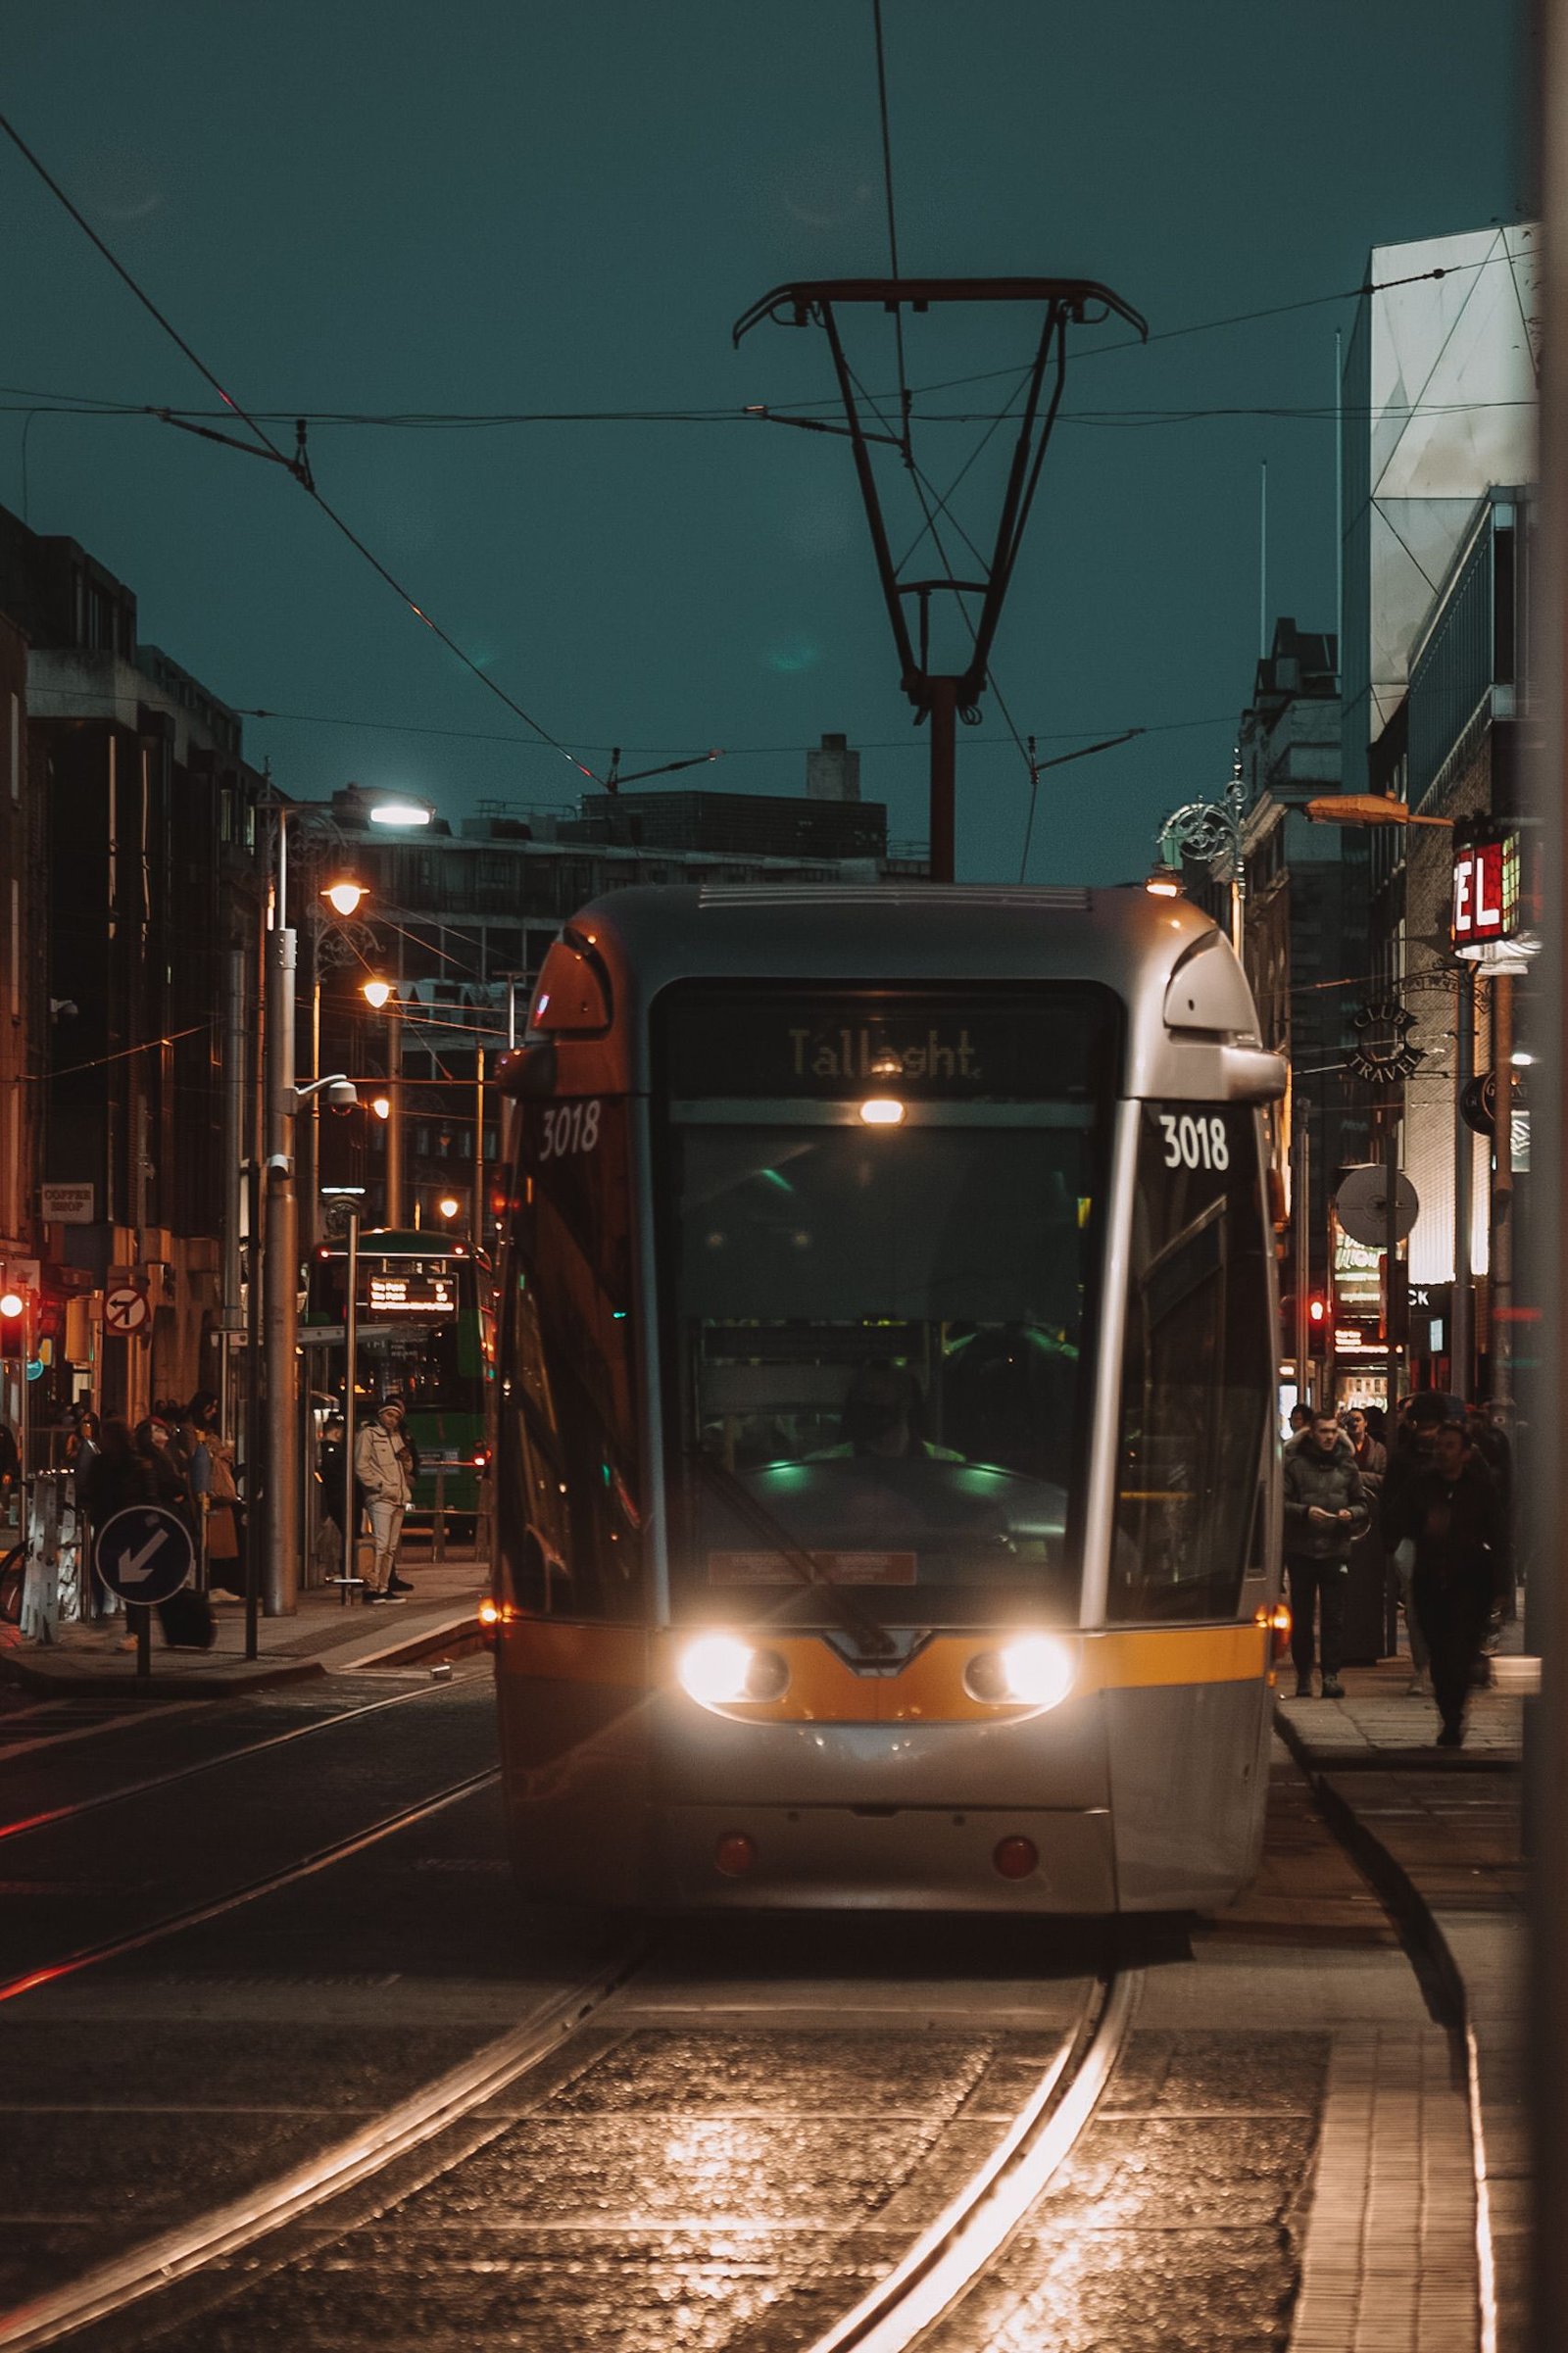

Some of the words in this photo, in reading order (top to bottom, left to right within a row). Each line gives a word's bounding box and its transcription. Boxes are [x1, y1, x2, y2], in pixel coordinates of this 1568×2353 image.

[1353, 1005, 1408, 1028] CLUB
[788, 1028, 971, 1079] Tallaght
[1349, 1053, 1423, 1084] TRAVEL
[539, 1100, 602, 1162] 3018
[1158, 1114, 1230, 1171] 3018
[44, 1190, 91, 1201] COFFEE
[51, 1201, 83, 1212] SHOP
